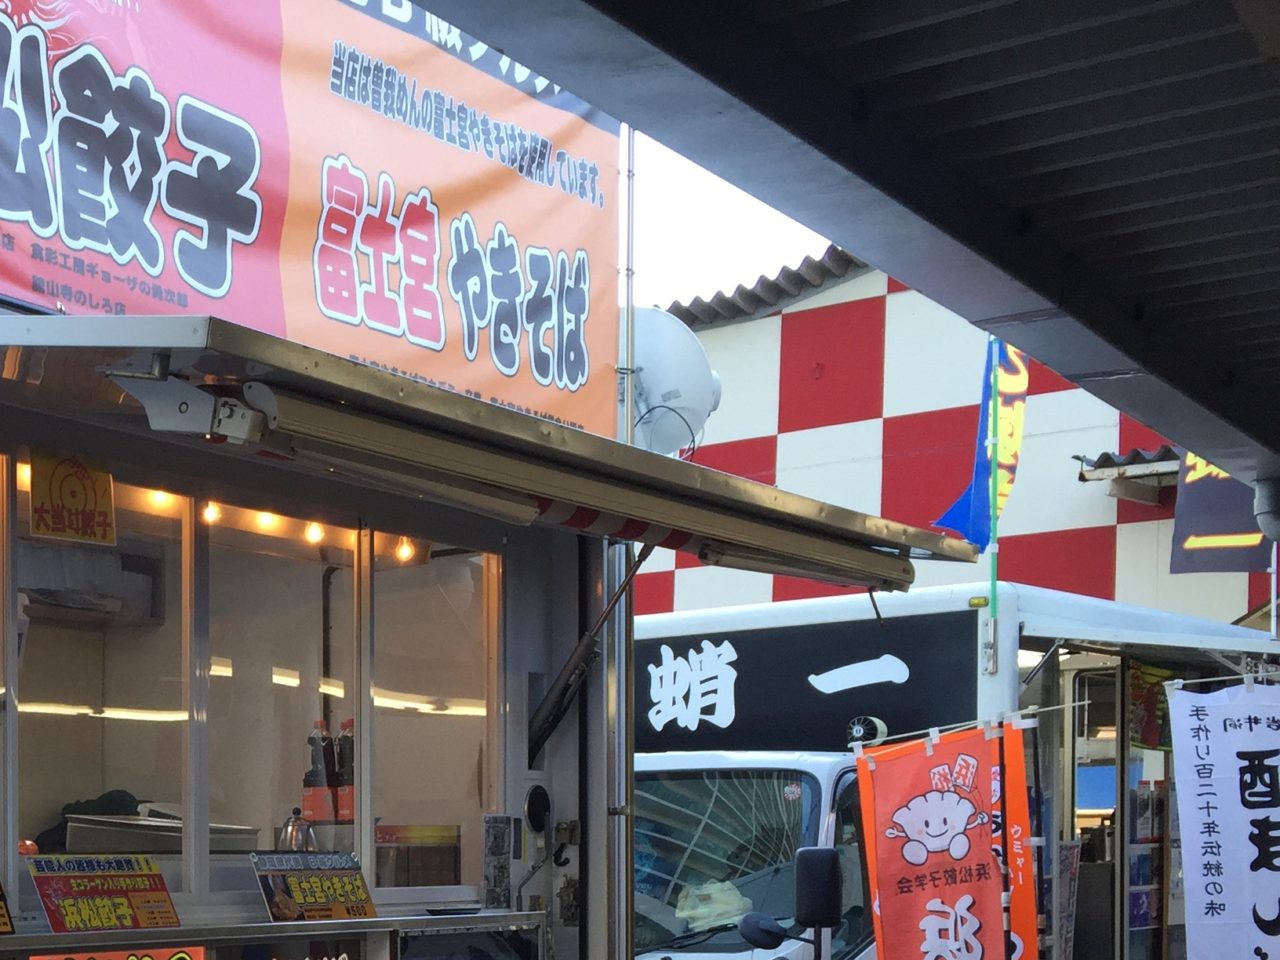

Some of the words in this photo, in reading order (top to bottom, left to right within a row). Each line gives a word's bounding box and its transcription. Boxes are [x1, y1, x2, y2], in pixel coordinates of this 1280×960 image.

[314, 153, 590, 393] 富士宮やきそば
[60, 894, 135, 930] 浜松餃子
